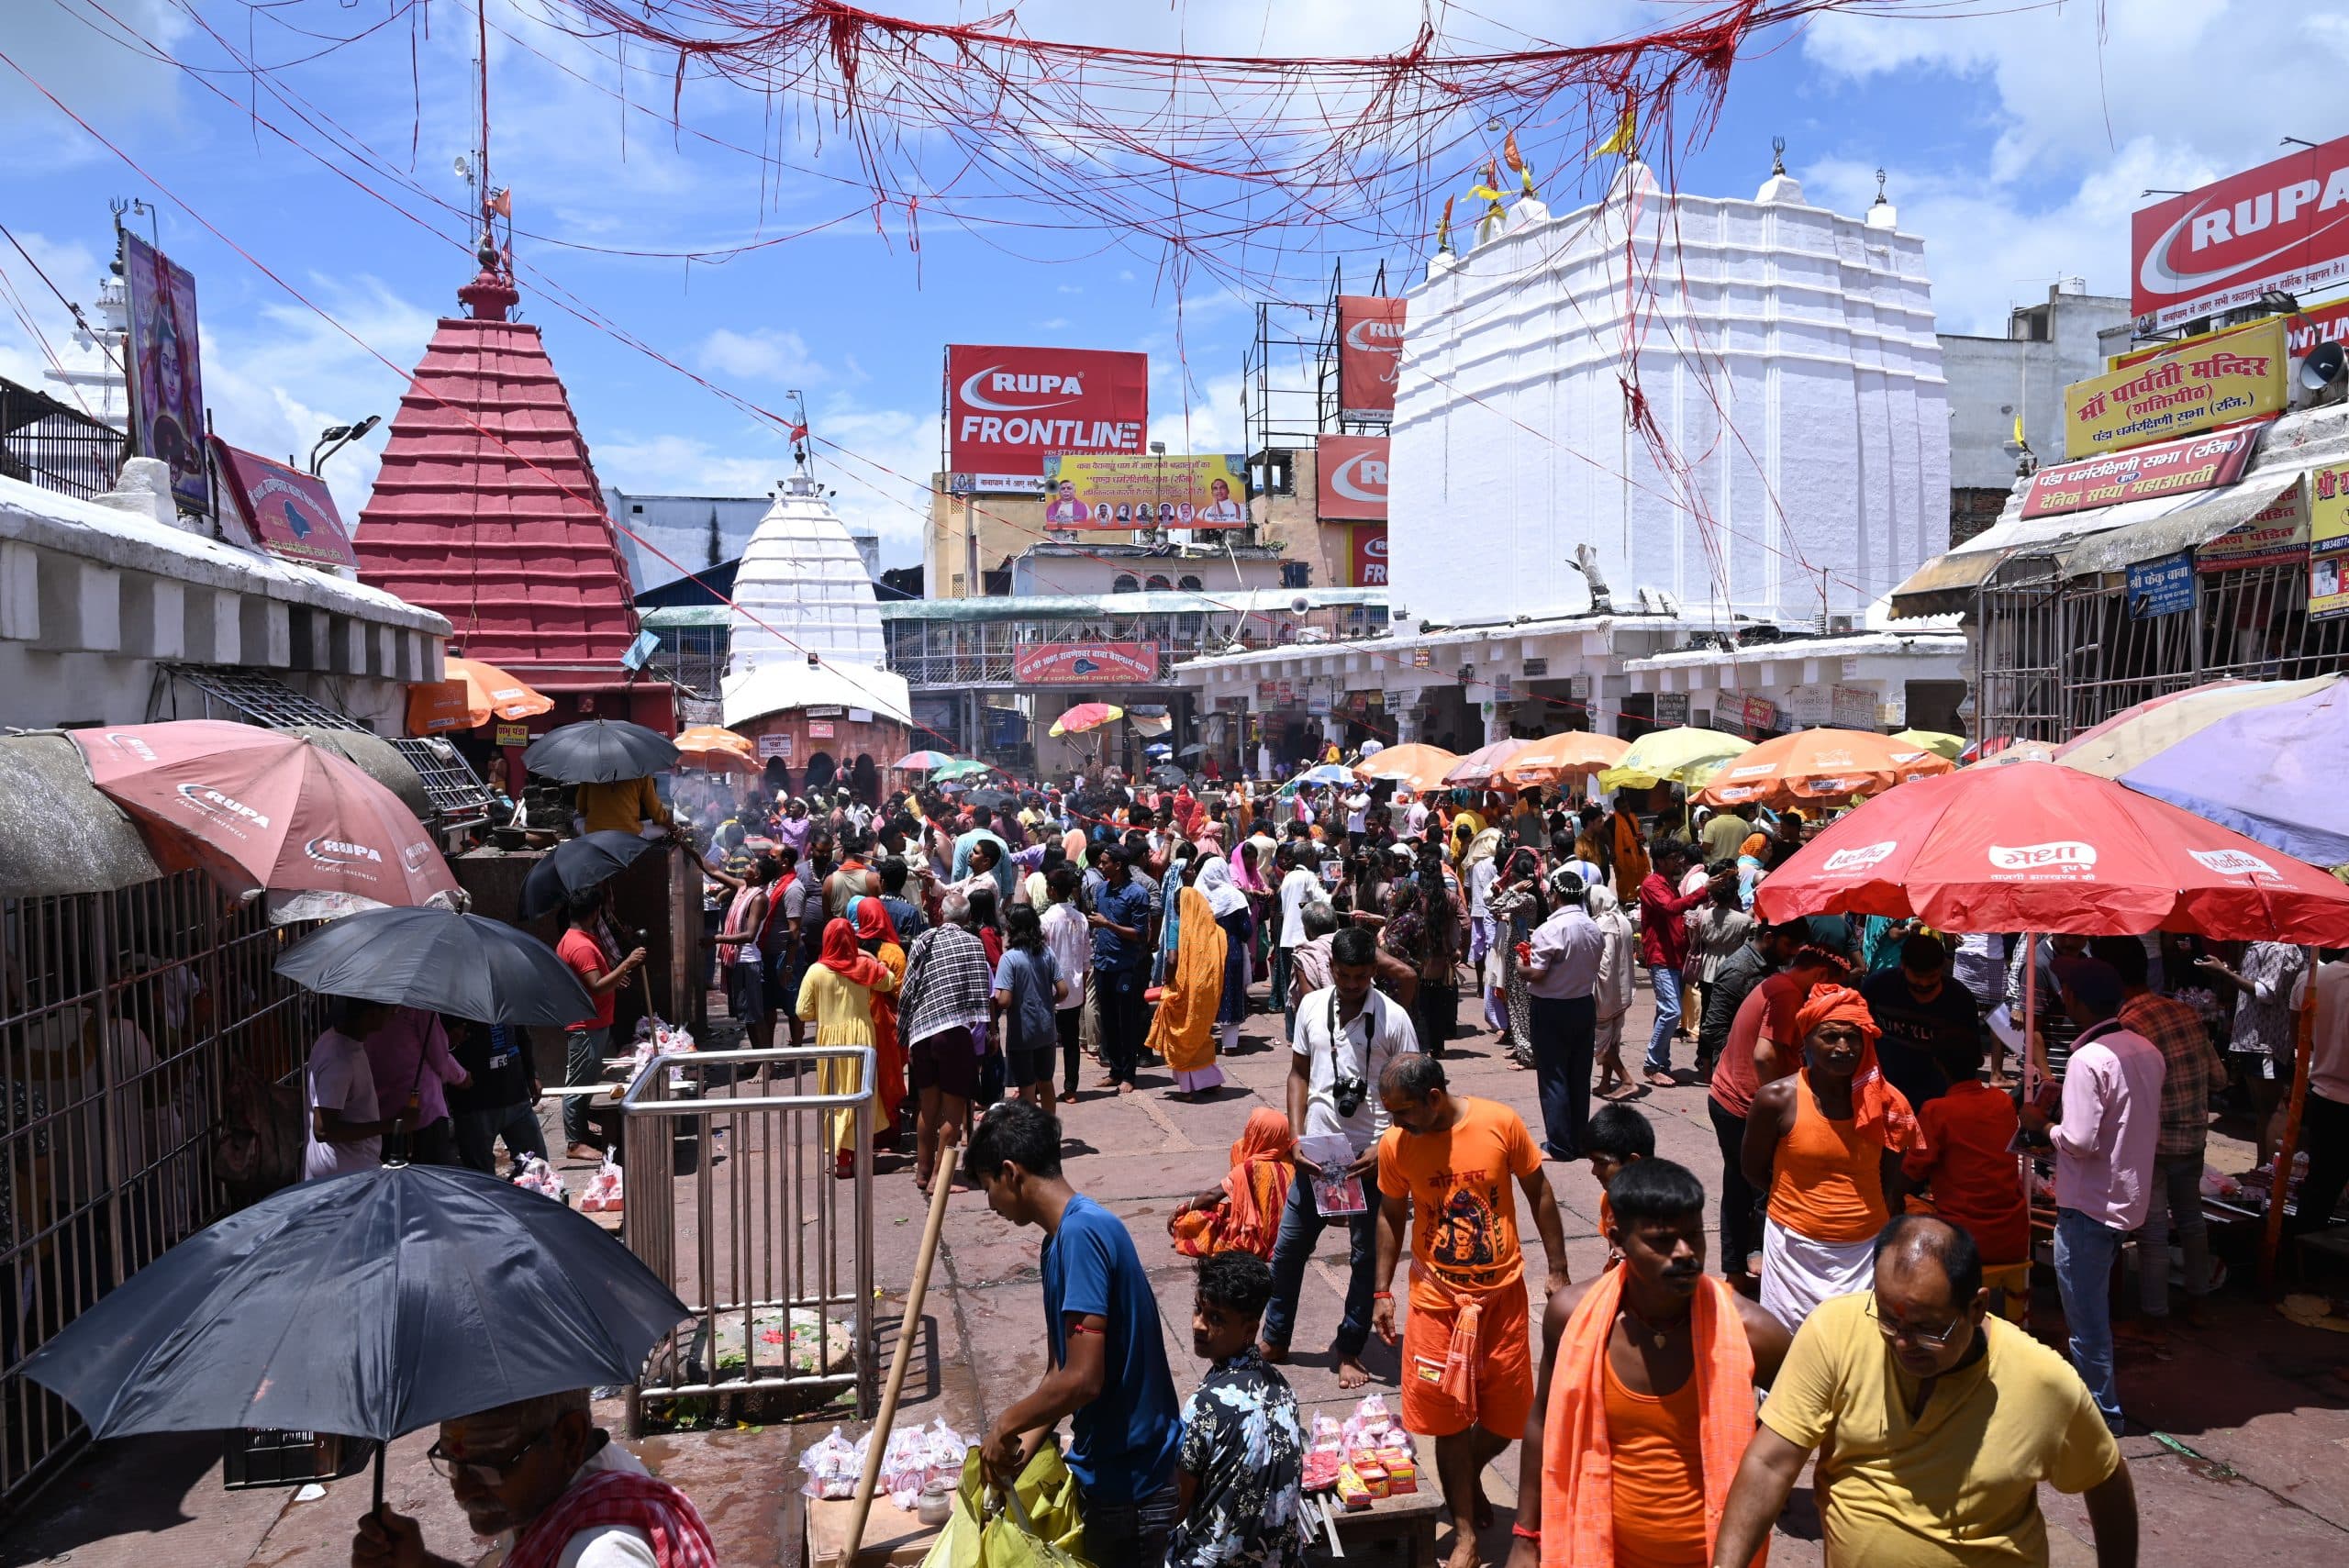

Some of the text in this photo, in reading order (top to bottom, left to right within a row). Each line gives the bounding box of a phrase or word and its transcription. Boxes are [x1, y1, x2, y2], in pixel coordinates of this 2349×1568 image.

[2192, 166, 2349, 252] RUPA
[2214, 295, 2229, 307] सभी
[2305, 268, 2331, 283] स्वागत
[992, 373, 1083, 395] RUPA
[2110, 363, 2184, 404] पार्वती
[2188, 352, 2272, 379] मन्दिर
[2125, 382, 2214, 420] (शक्तिपीठ)
[960, 415, 1141, 449] FRONTLINE
[2092, 429, 2112, 442] पंडा
[2116, 413, 2174, 437] धर्मरक्षिणी
[2176, 406, 2206, 422] सभा
[2040, 471, 2065, 486] पंडा
[2067, 457, 2140, 482] धर्मरक्षिणी
[2143, 448, 2180, 469] सभा
[2040, 491, 2082, 510] दैनिक
[2132, 464, 2218, 495] महाआरती
[2318, 470, 2337, 500] श्री
[1364, 563, 1388, 584] FR
[2130, 575, 2142, 589] श्री
[2167, 567, 2188, 580] बाबा
[205, 790, 270, 829] RUPA
[323, 840, 383, 862] RUPA
[405, 840, 430, 860] RUPA
[2003, 846, 2081, 864] मेधा
[1428, 1169, 1486, 1189] बोल बम
